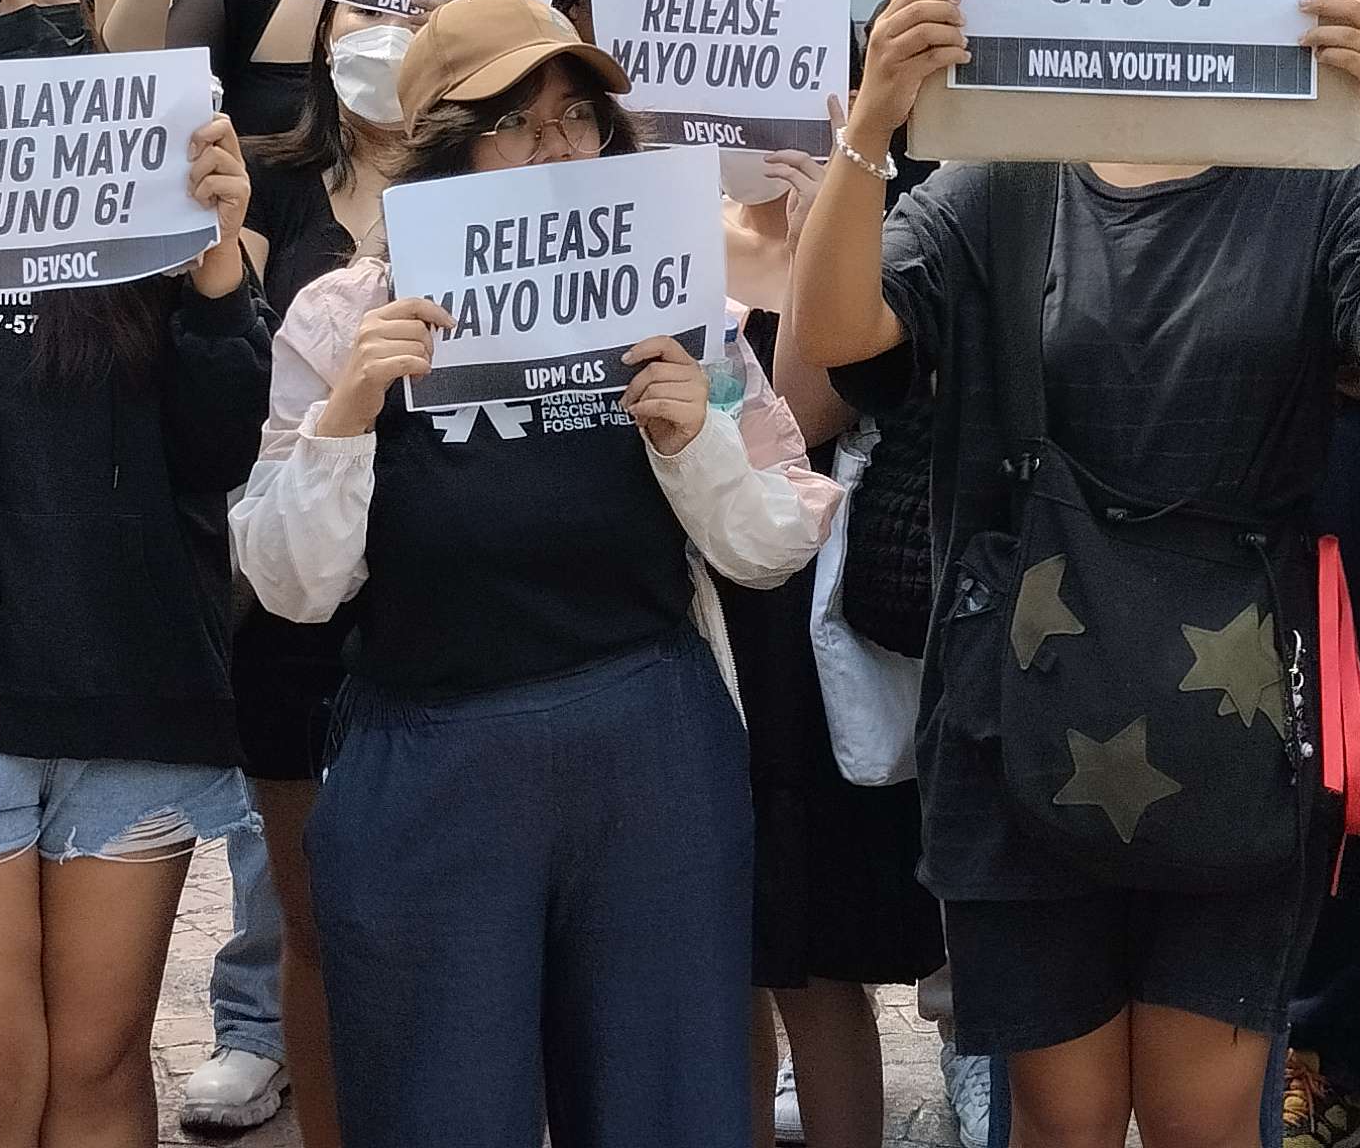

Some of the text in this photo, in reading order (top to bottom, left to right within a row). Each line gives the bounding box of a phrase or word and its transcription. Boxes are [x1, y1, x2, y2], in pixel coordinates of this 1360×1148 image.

[612, 39, 827, 90] MAYO UNO 6!
[1028, 49, 1235, 83] NNARA YOUTH UPM
[683, 121, 746, 146] DEVSOC
[52, 126, 167, 178] MAYO
[94, 181, 134, 225] 6!
[464, 202, 635, 277] RELEASE
[22, 253, 99, 282] DEVSOC
[552, 264, 639, 325] UNO
[652, 254, 691, 309] 6!
[524, 360, 606, 390] UPM CAS
[541, 392, 602, 406] AGAINST
[541, 401, 606, 419] FASCISM
[543, 413, 636, 433] FOSSIL FUEL
